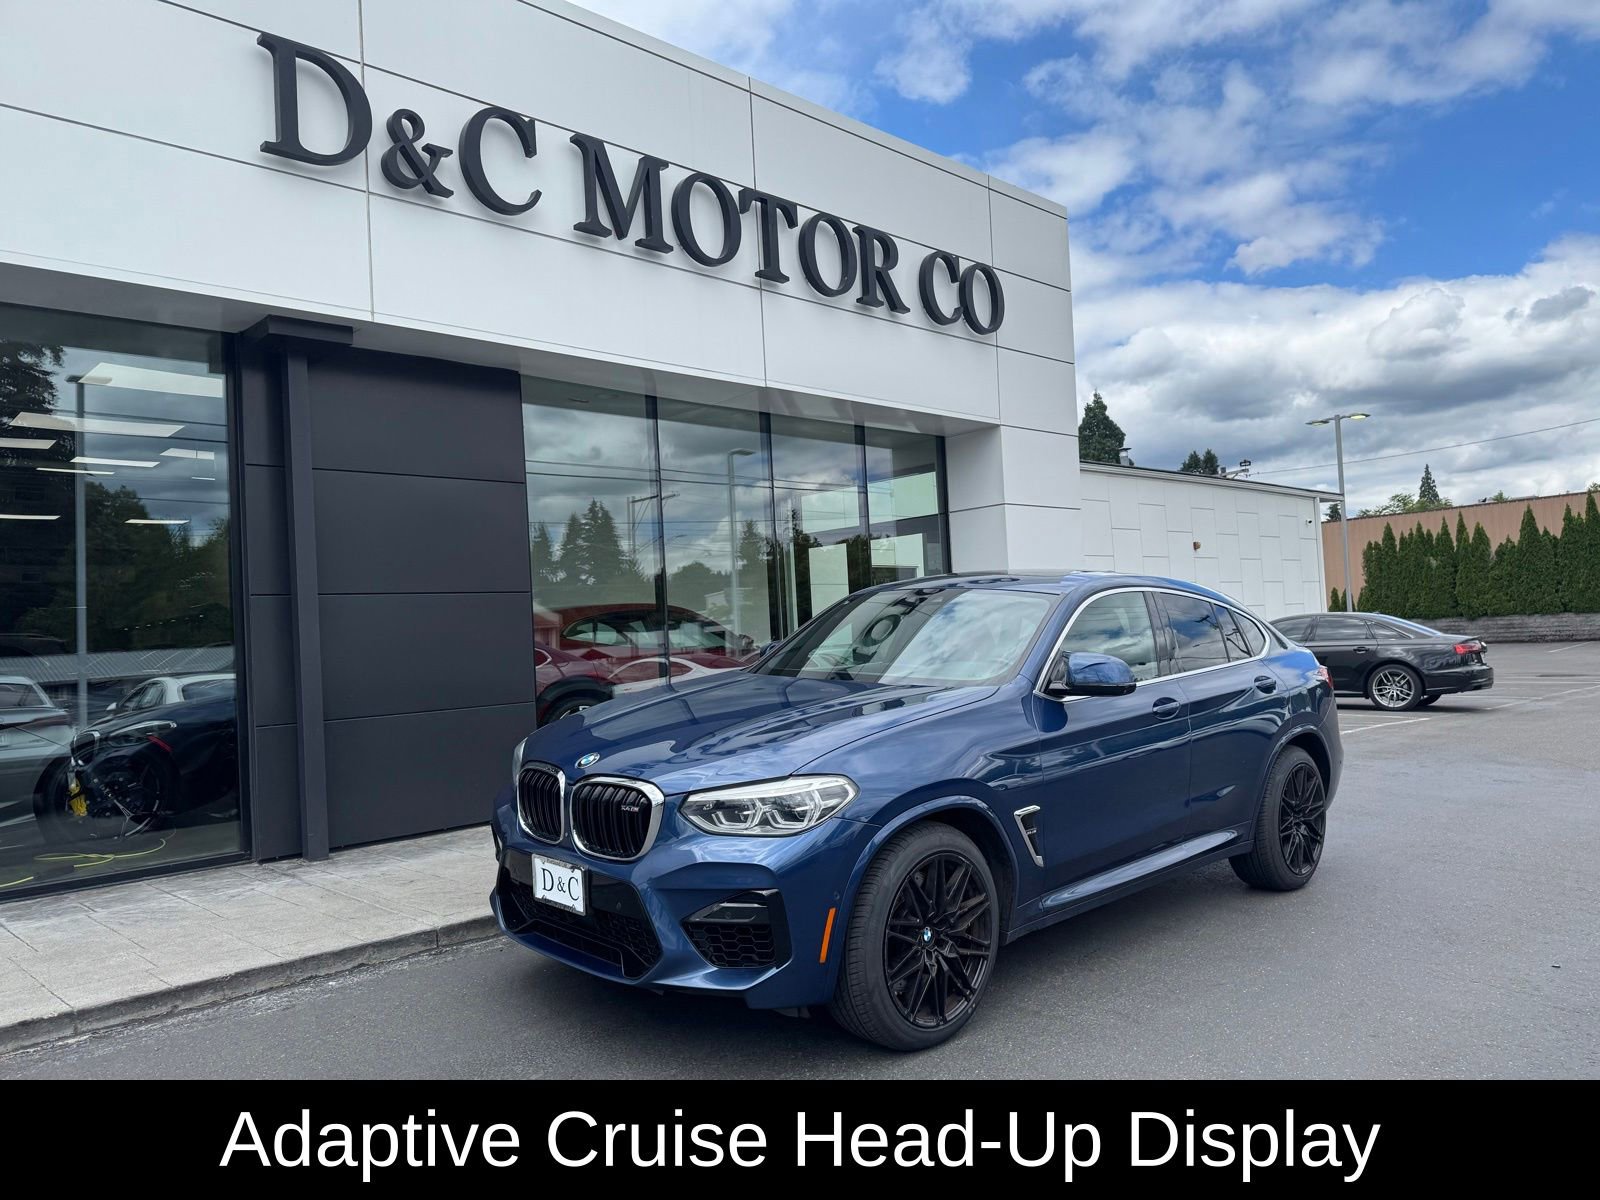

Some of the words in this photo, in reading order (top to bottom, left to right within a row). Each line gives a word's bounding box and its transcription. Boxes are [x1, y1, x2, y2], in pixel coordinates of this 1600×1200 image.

[256, 32, 542, 216] D&C
[569, 132, 911, 315] MOTOR
[918, 250, 1006, 335] CO
